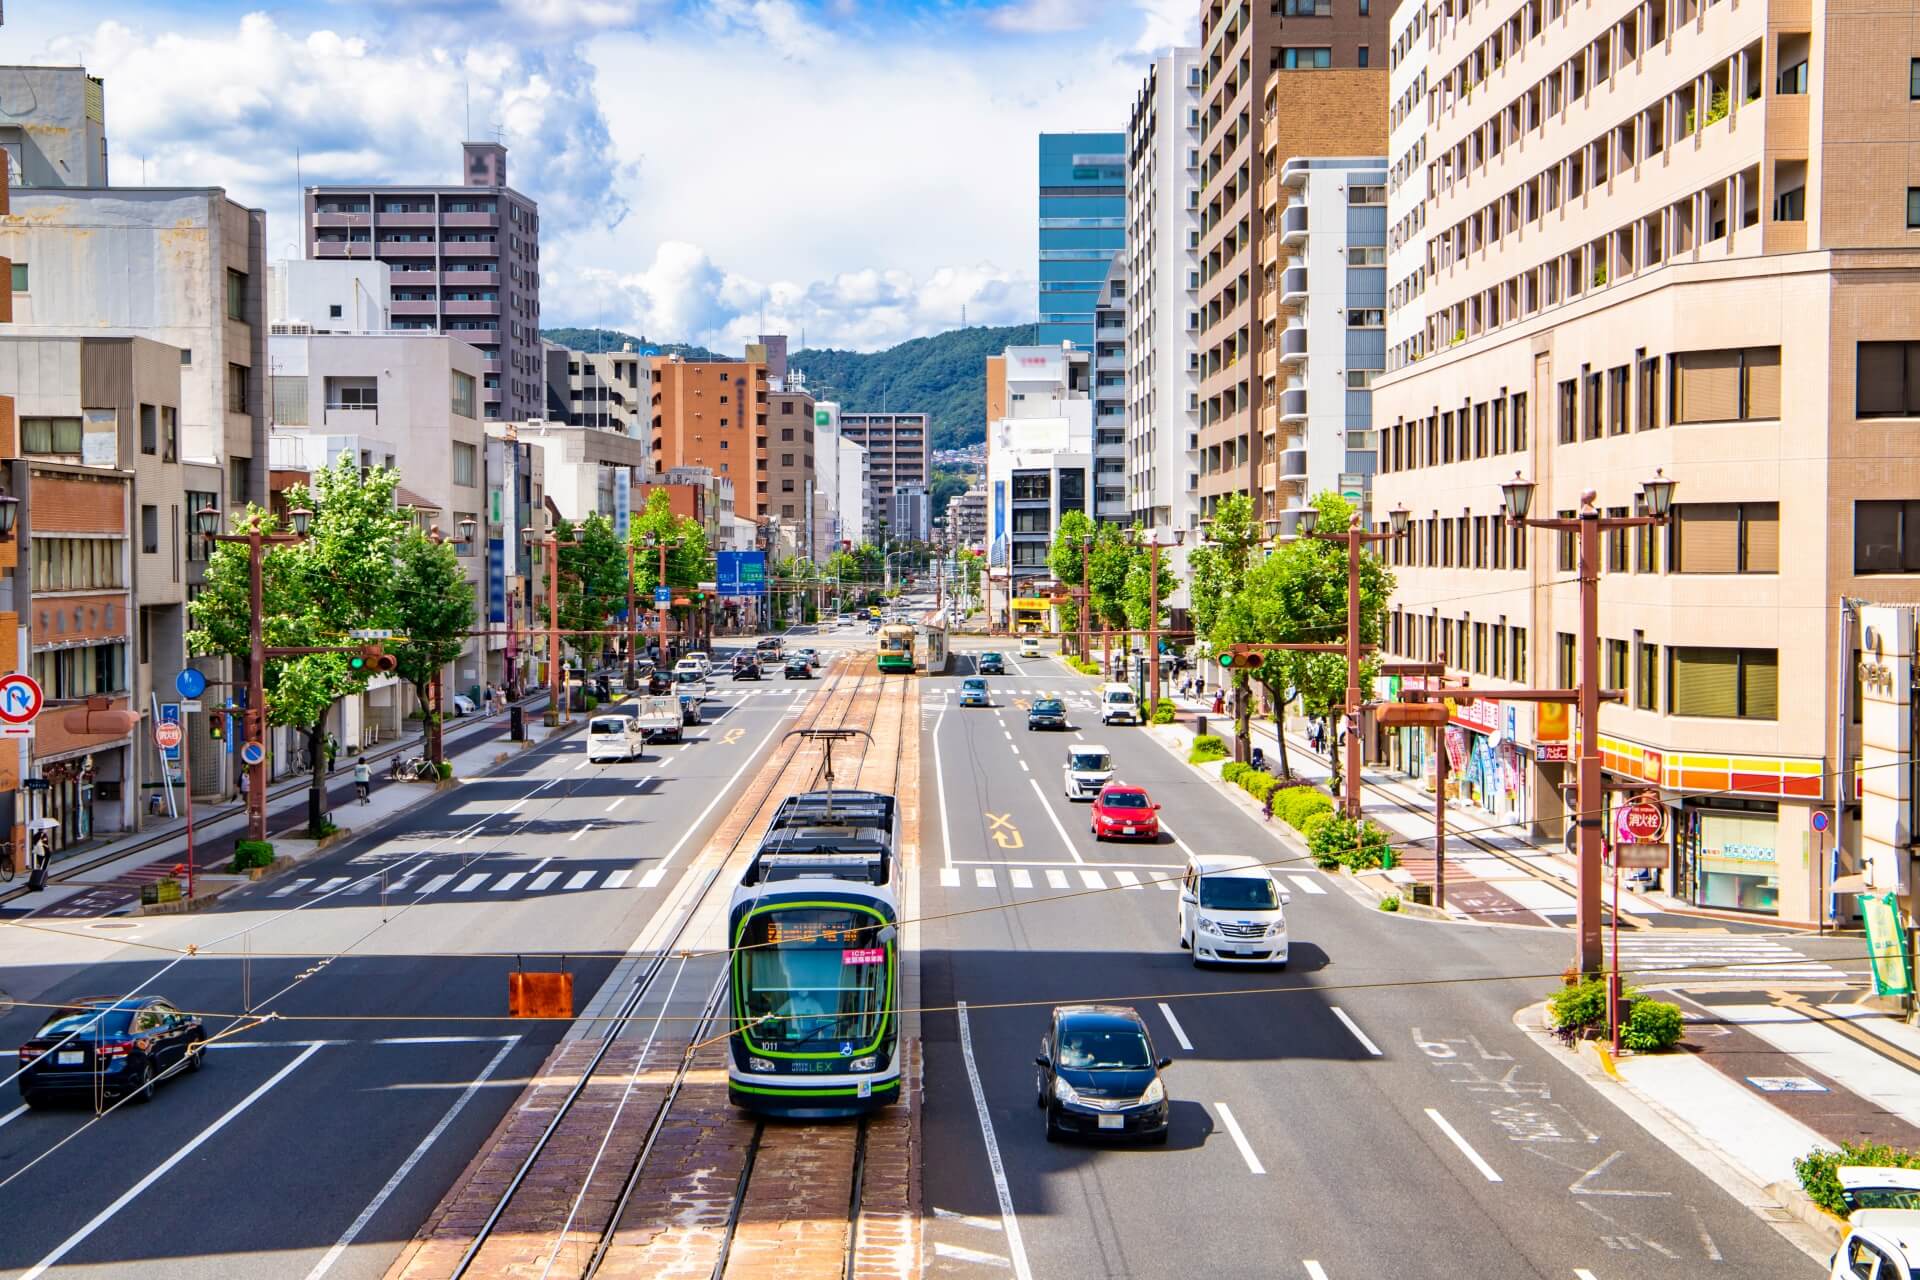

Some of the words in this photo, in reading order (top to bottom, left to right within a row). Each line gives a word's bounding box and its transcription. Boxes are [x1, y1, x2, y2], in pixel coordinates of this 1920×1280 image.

[1547, 747, 1567, 759] たばこ
[1629, 813, 1658, 828] 消火栓
[762, 1042, 777, 1051] 1011
[809, 1062, 833, 1073] LEX
